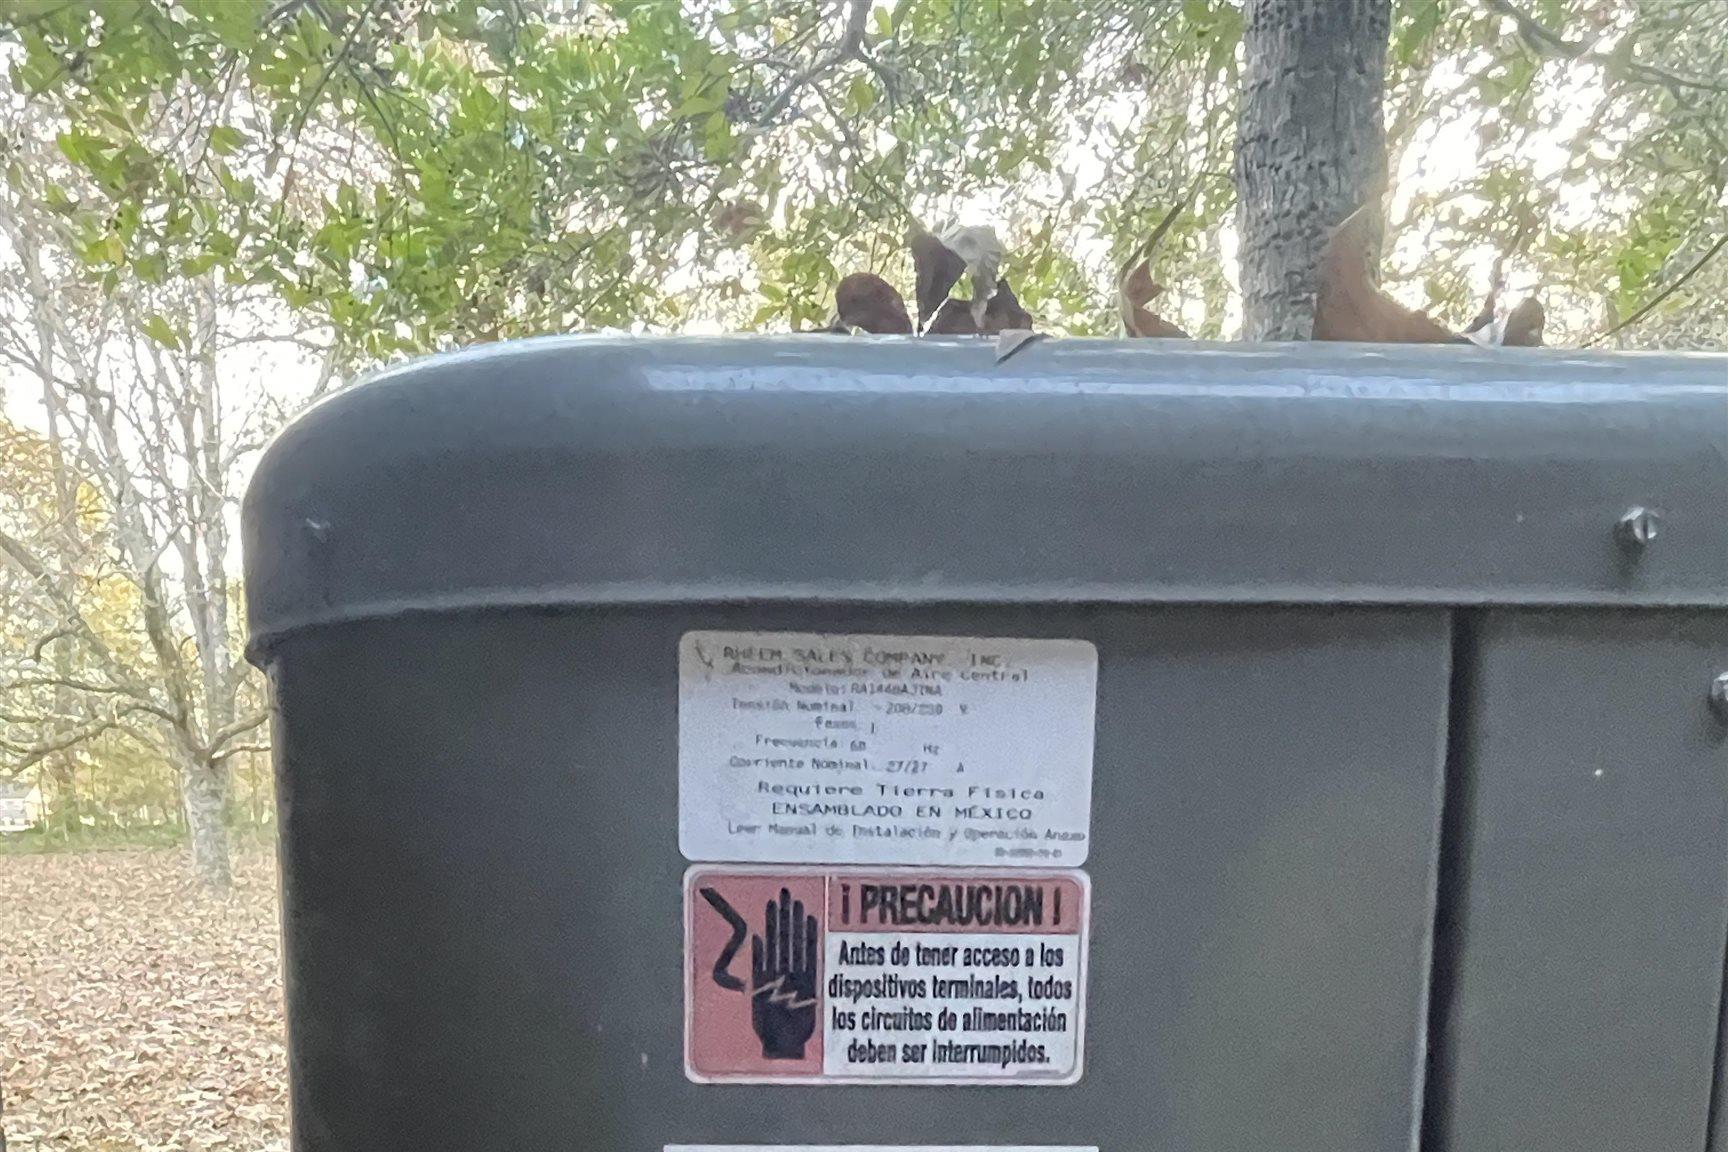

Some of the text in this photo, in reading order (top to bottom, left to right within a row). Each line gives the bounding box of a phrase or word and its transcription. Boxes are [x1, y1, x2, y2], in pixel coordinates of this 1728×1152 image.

[863, 648, 945, 664] COMPANY
[758, 780, 863, 797] Requiere
[876, 784, 954, 798] Tierra
[772, 802, 902, 818] ENSAMBLADO
[916, 805, 941, 819] EN
[838, 940, 1064, 967] Antes de tener acceso a los
[828, 973, 1072, 1004] dispositivos terminales, todos
[832, 1006, 1067, 1032] los circuitos de alimentación
[848, 1038, 1050, 1069] deben ser interrumpidos.
